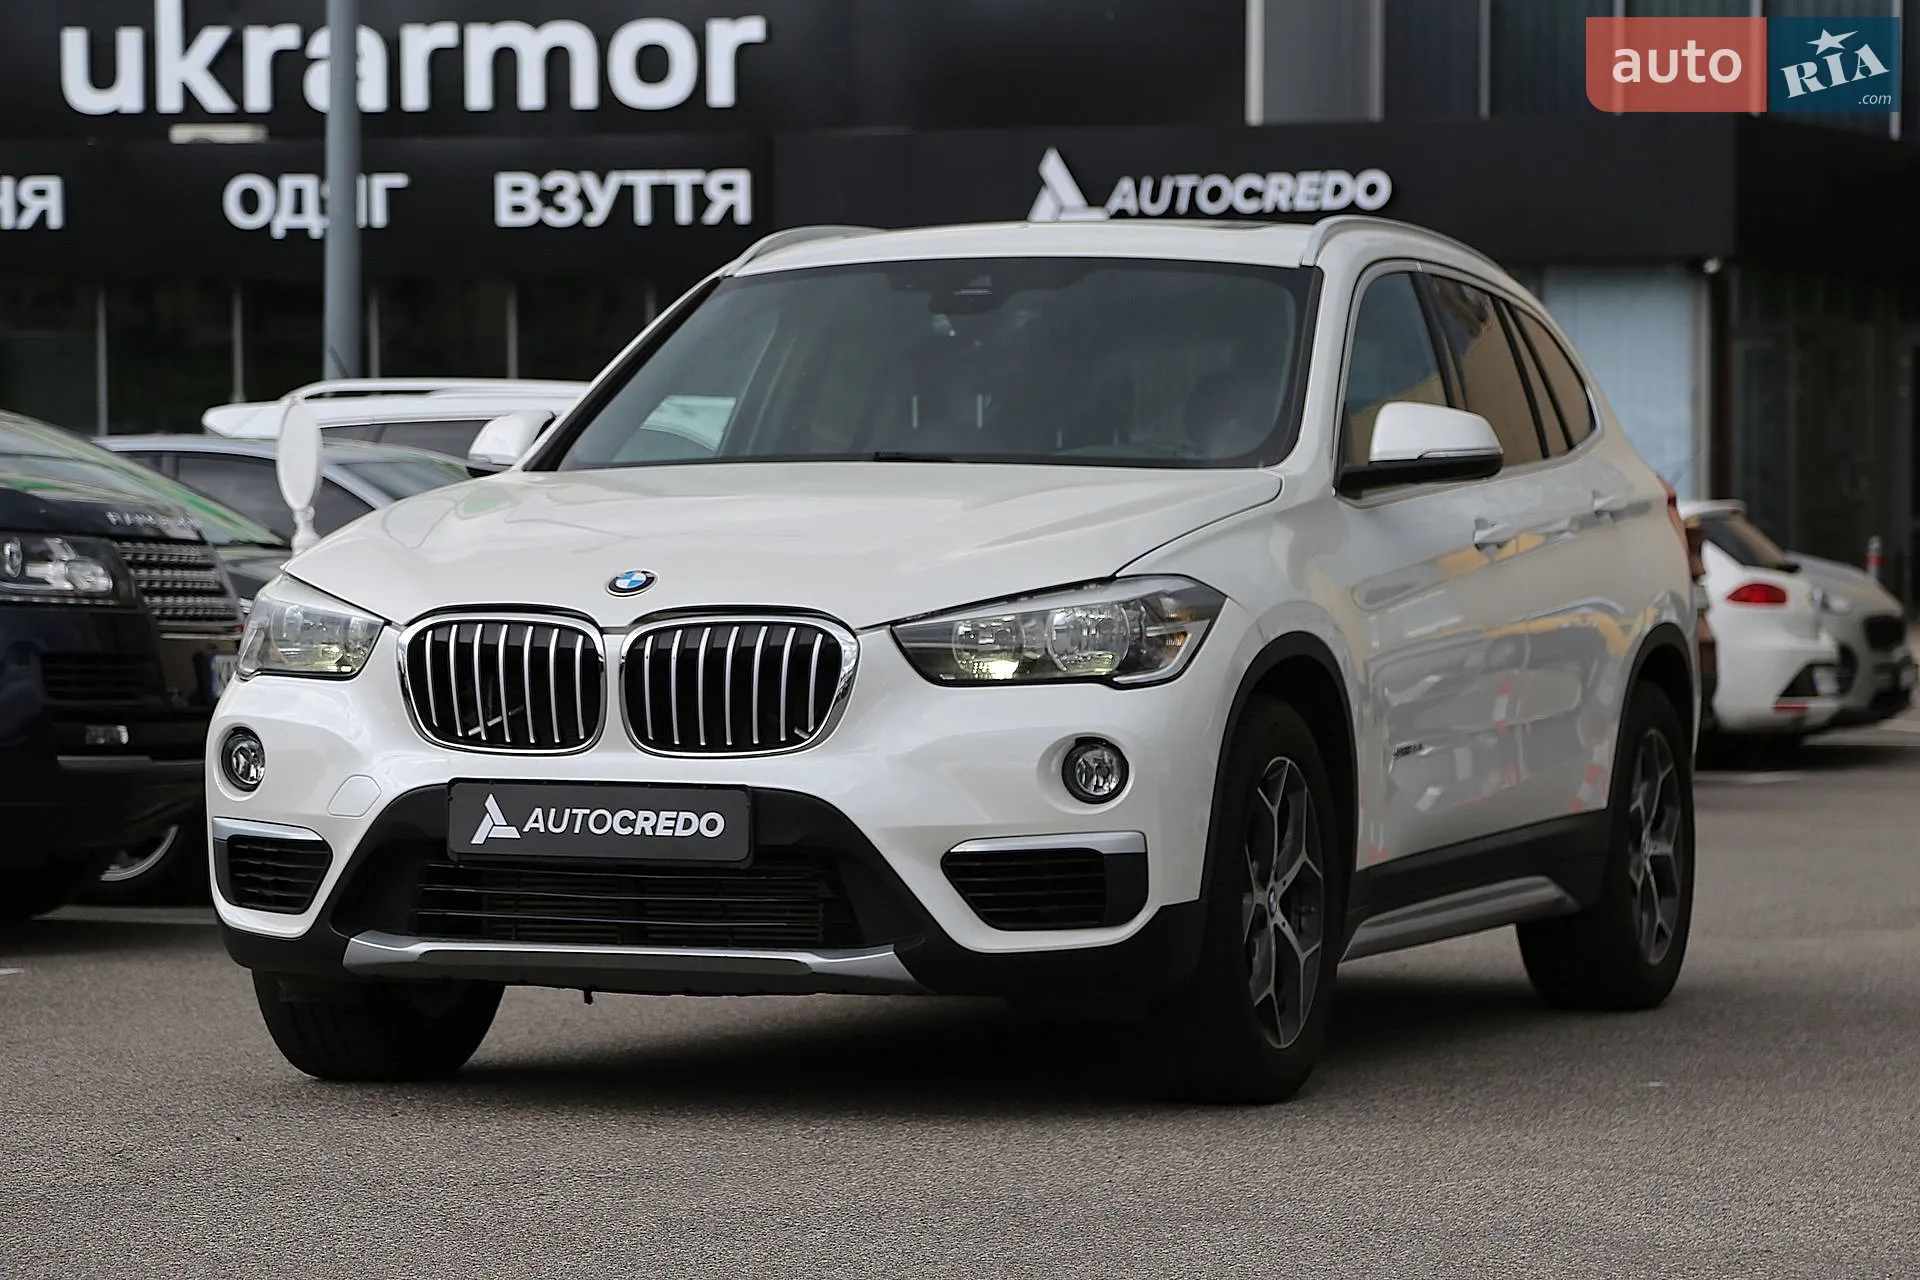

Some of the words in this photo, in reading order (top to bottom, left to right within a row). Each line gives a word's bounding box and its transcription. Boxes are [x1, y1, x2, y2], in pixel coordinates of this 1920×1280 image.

[60, 0, 766, 114] ukrarmor
[494, 168, 752, 226] ВЗУТТЯ
[1106, 168, 1393, 217] AUTOCREDO
[523, 807, 725, 838] AUTOCREDO
